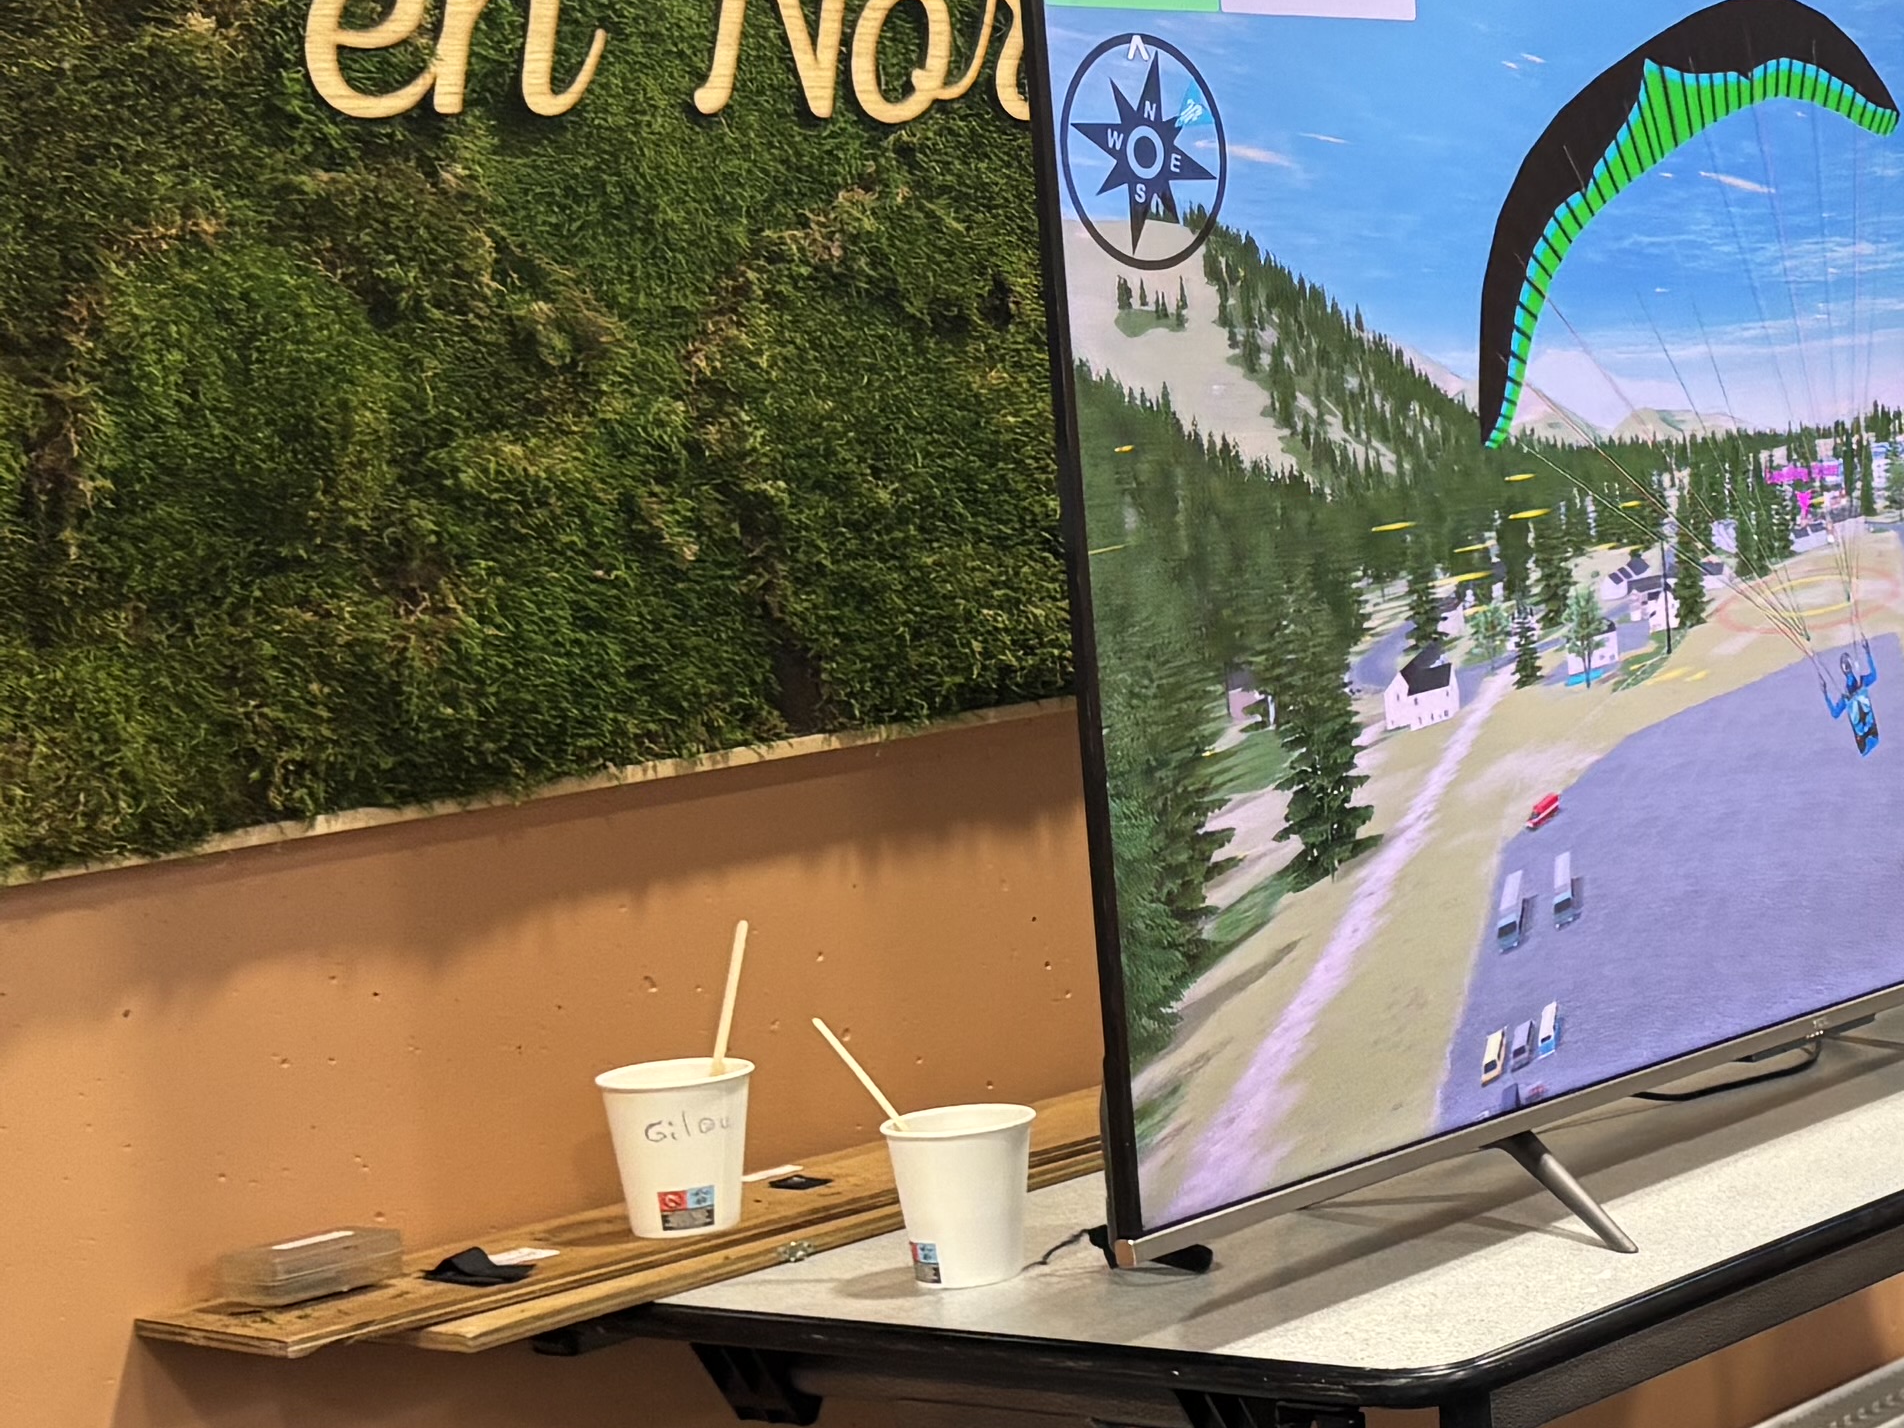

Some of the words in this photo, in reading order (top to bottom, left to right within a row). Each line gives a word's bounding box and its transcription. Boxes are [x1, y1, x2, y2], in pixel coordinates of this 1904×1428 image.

[1143, 100, 1157, 122] N
[1107, 128, 1124, 151] W
[1170, 153, 1182, 173] E
[1134, 183, 1146, 204] S
